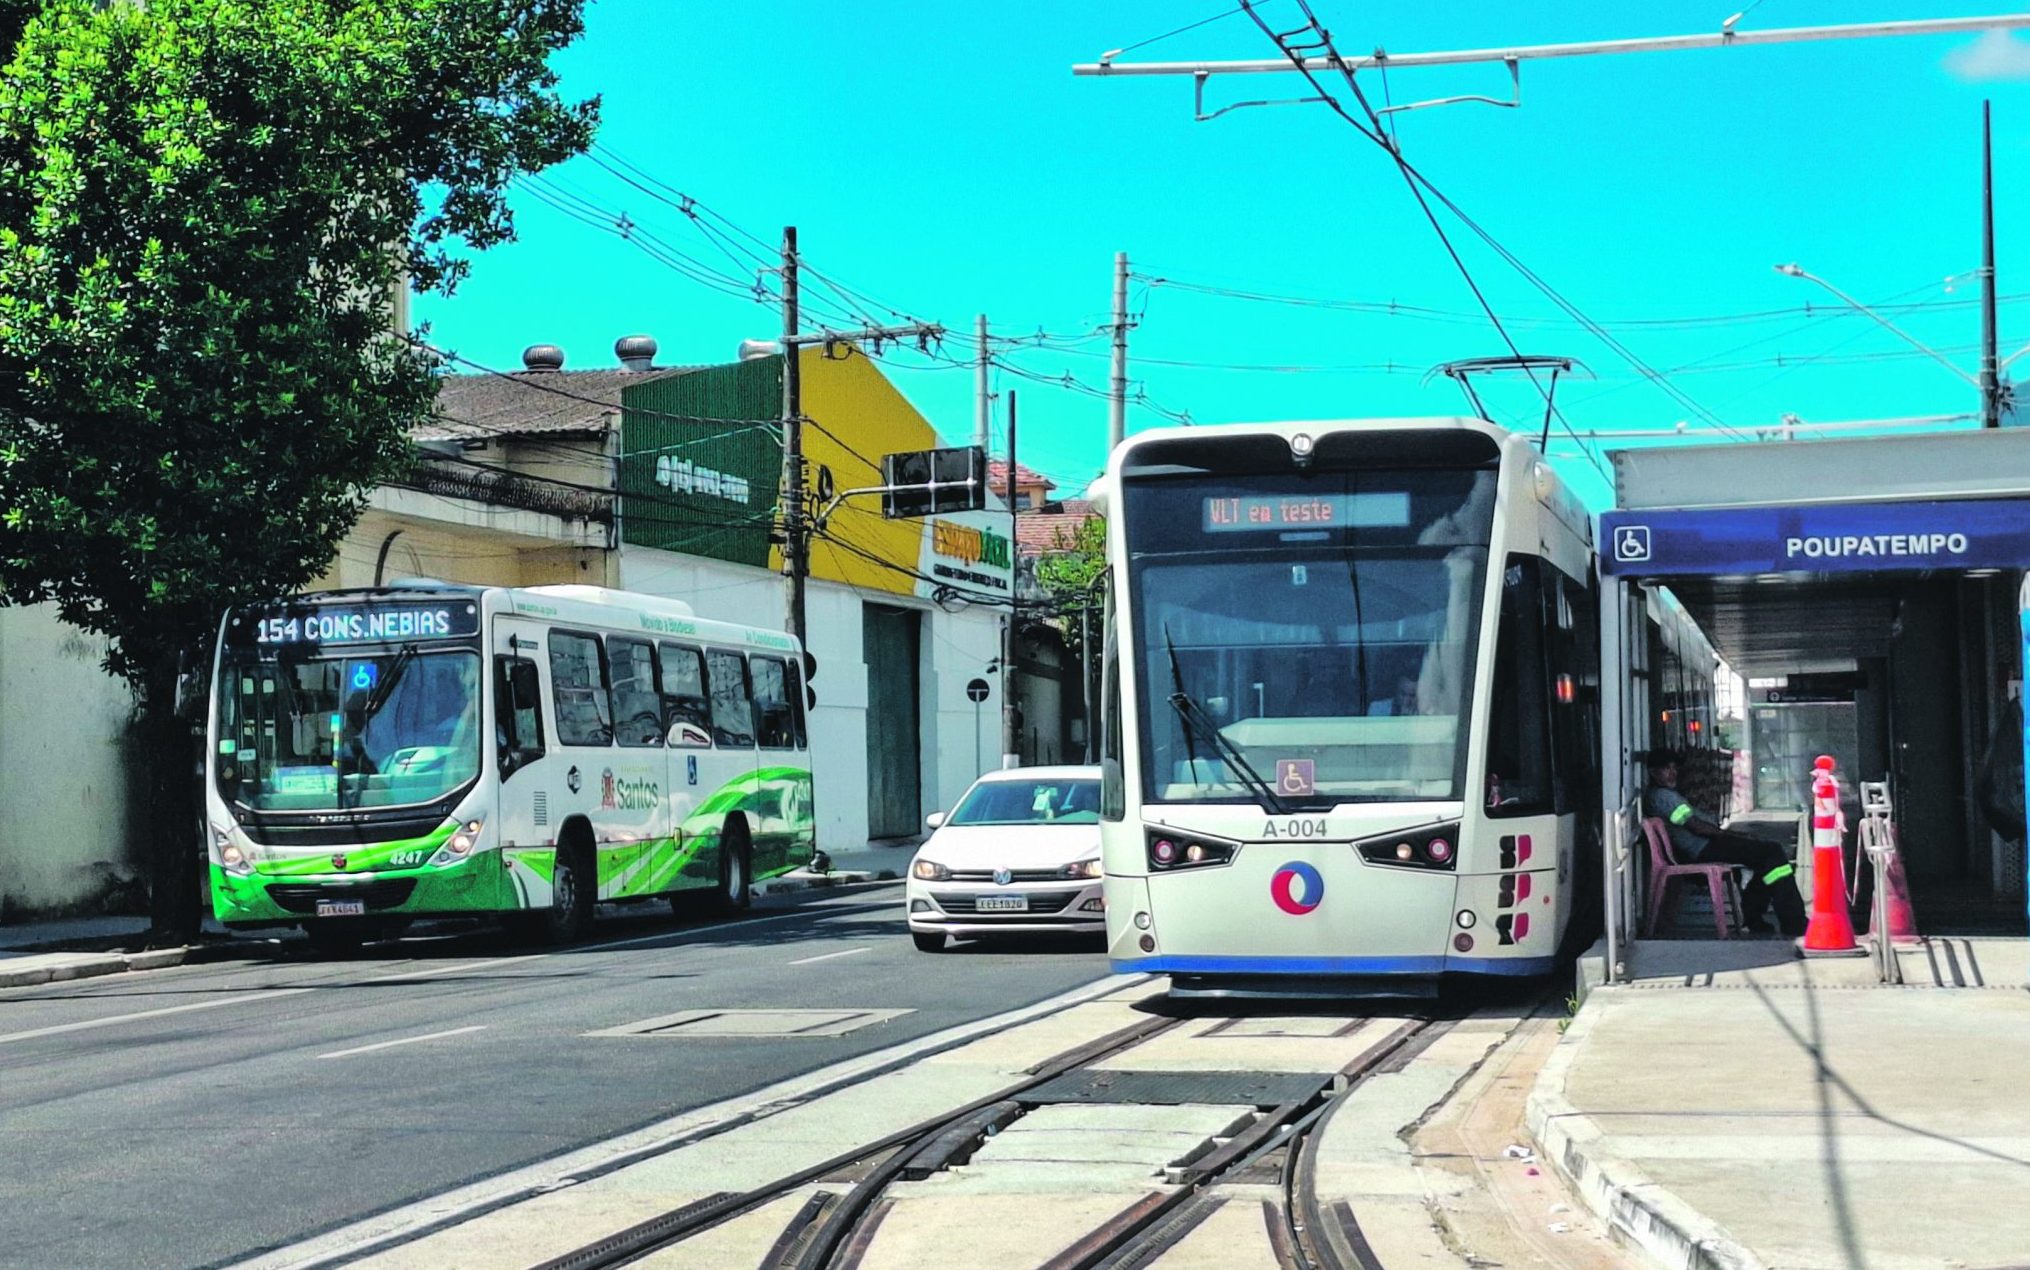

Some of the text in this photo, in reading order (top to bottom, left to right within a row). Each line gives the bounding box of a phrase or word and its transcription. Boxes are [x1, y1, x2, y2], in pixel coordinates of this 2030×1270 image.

[1210, 498, 1332, 524] VLT em teste
[1786, 533, 1968, 558] POUPATEMPO
[257, 610, 450, 643] 154 CONS.NEBIAS
[617, 776, 659, 810] Santos
[1262, 818, 1328, 839] A-004
[389, 850, 423, 866] 4247
